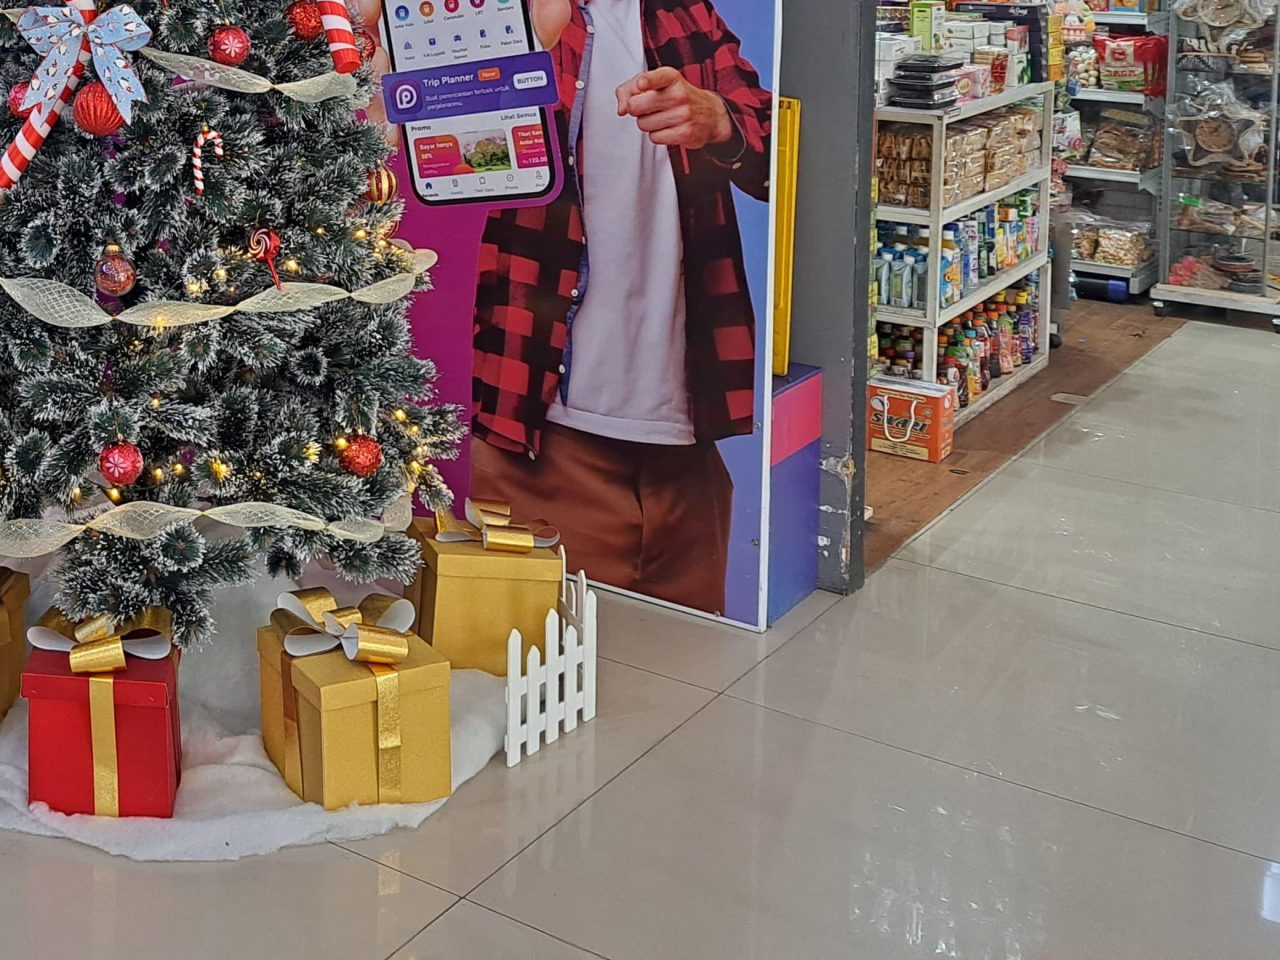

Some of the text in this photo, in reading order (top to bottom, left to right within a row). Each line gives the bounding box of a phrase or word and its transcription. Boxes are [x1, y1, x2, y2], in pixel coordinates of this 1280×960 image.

[423, 78, 440, 88] Trip
[441, 73, 474, 86] Planner
[517, 75, 544, 85] BUTTON
[410, 124, 431, 132] Promo
[516, 111, 537, 120] Semua
